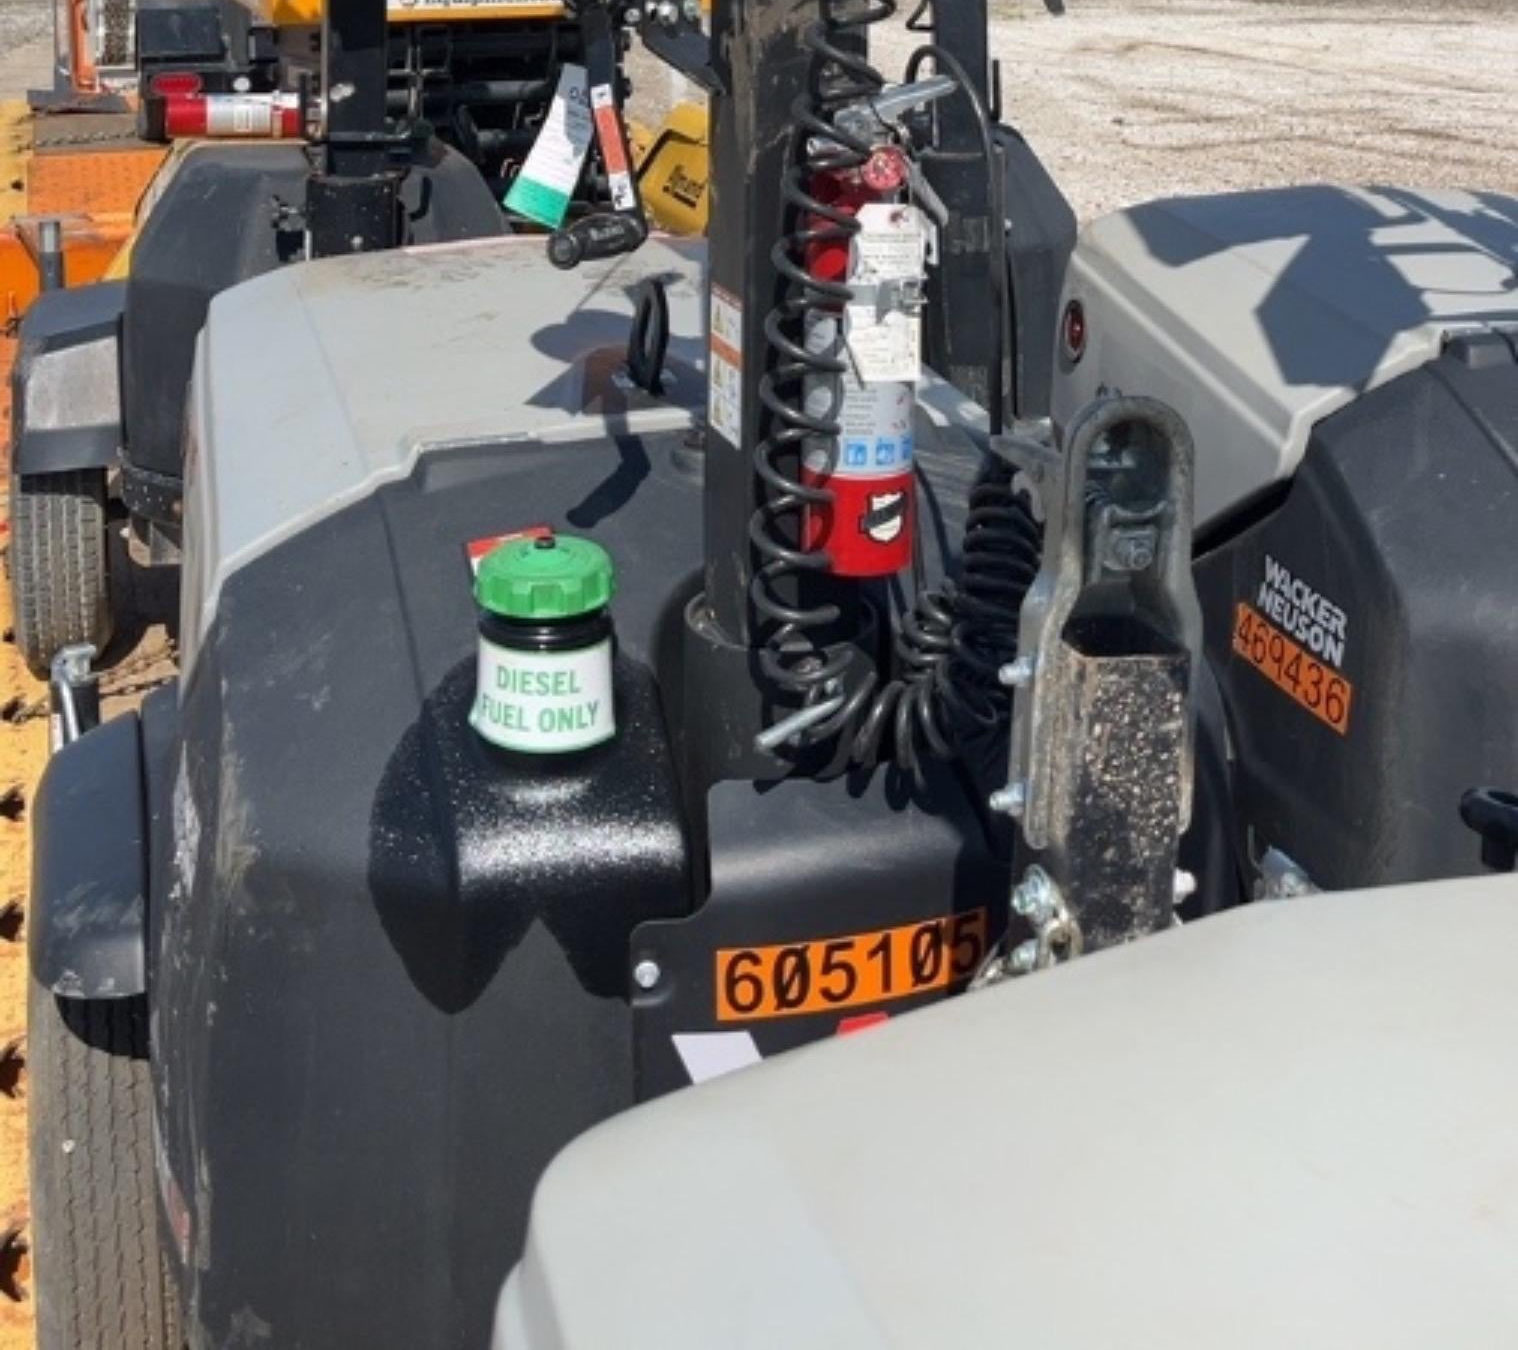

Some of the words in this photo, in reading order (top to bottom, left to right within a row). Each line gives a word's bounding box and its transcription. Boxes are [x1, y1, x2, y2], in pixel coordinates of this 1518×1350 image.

[1257, 582, 1345, 667] NEUSON
[1265, 554, 1348, 639] WACKER
[496, 664, 581, 696] DIESEL
[1239, 613, 1345, 724] 469436
[481, 693, 529, 732] FUEL
[537, 699, 599, 733] ONLY
